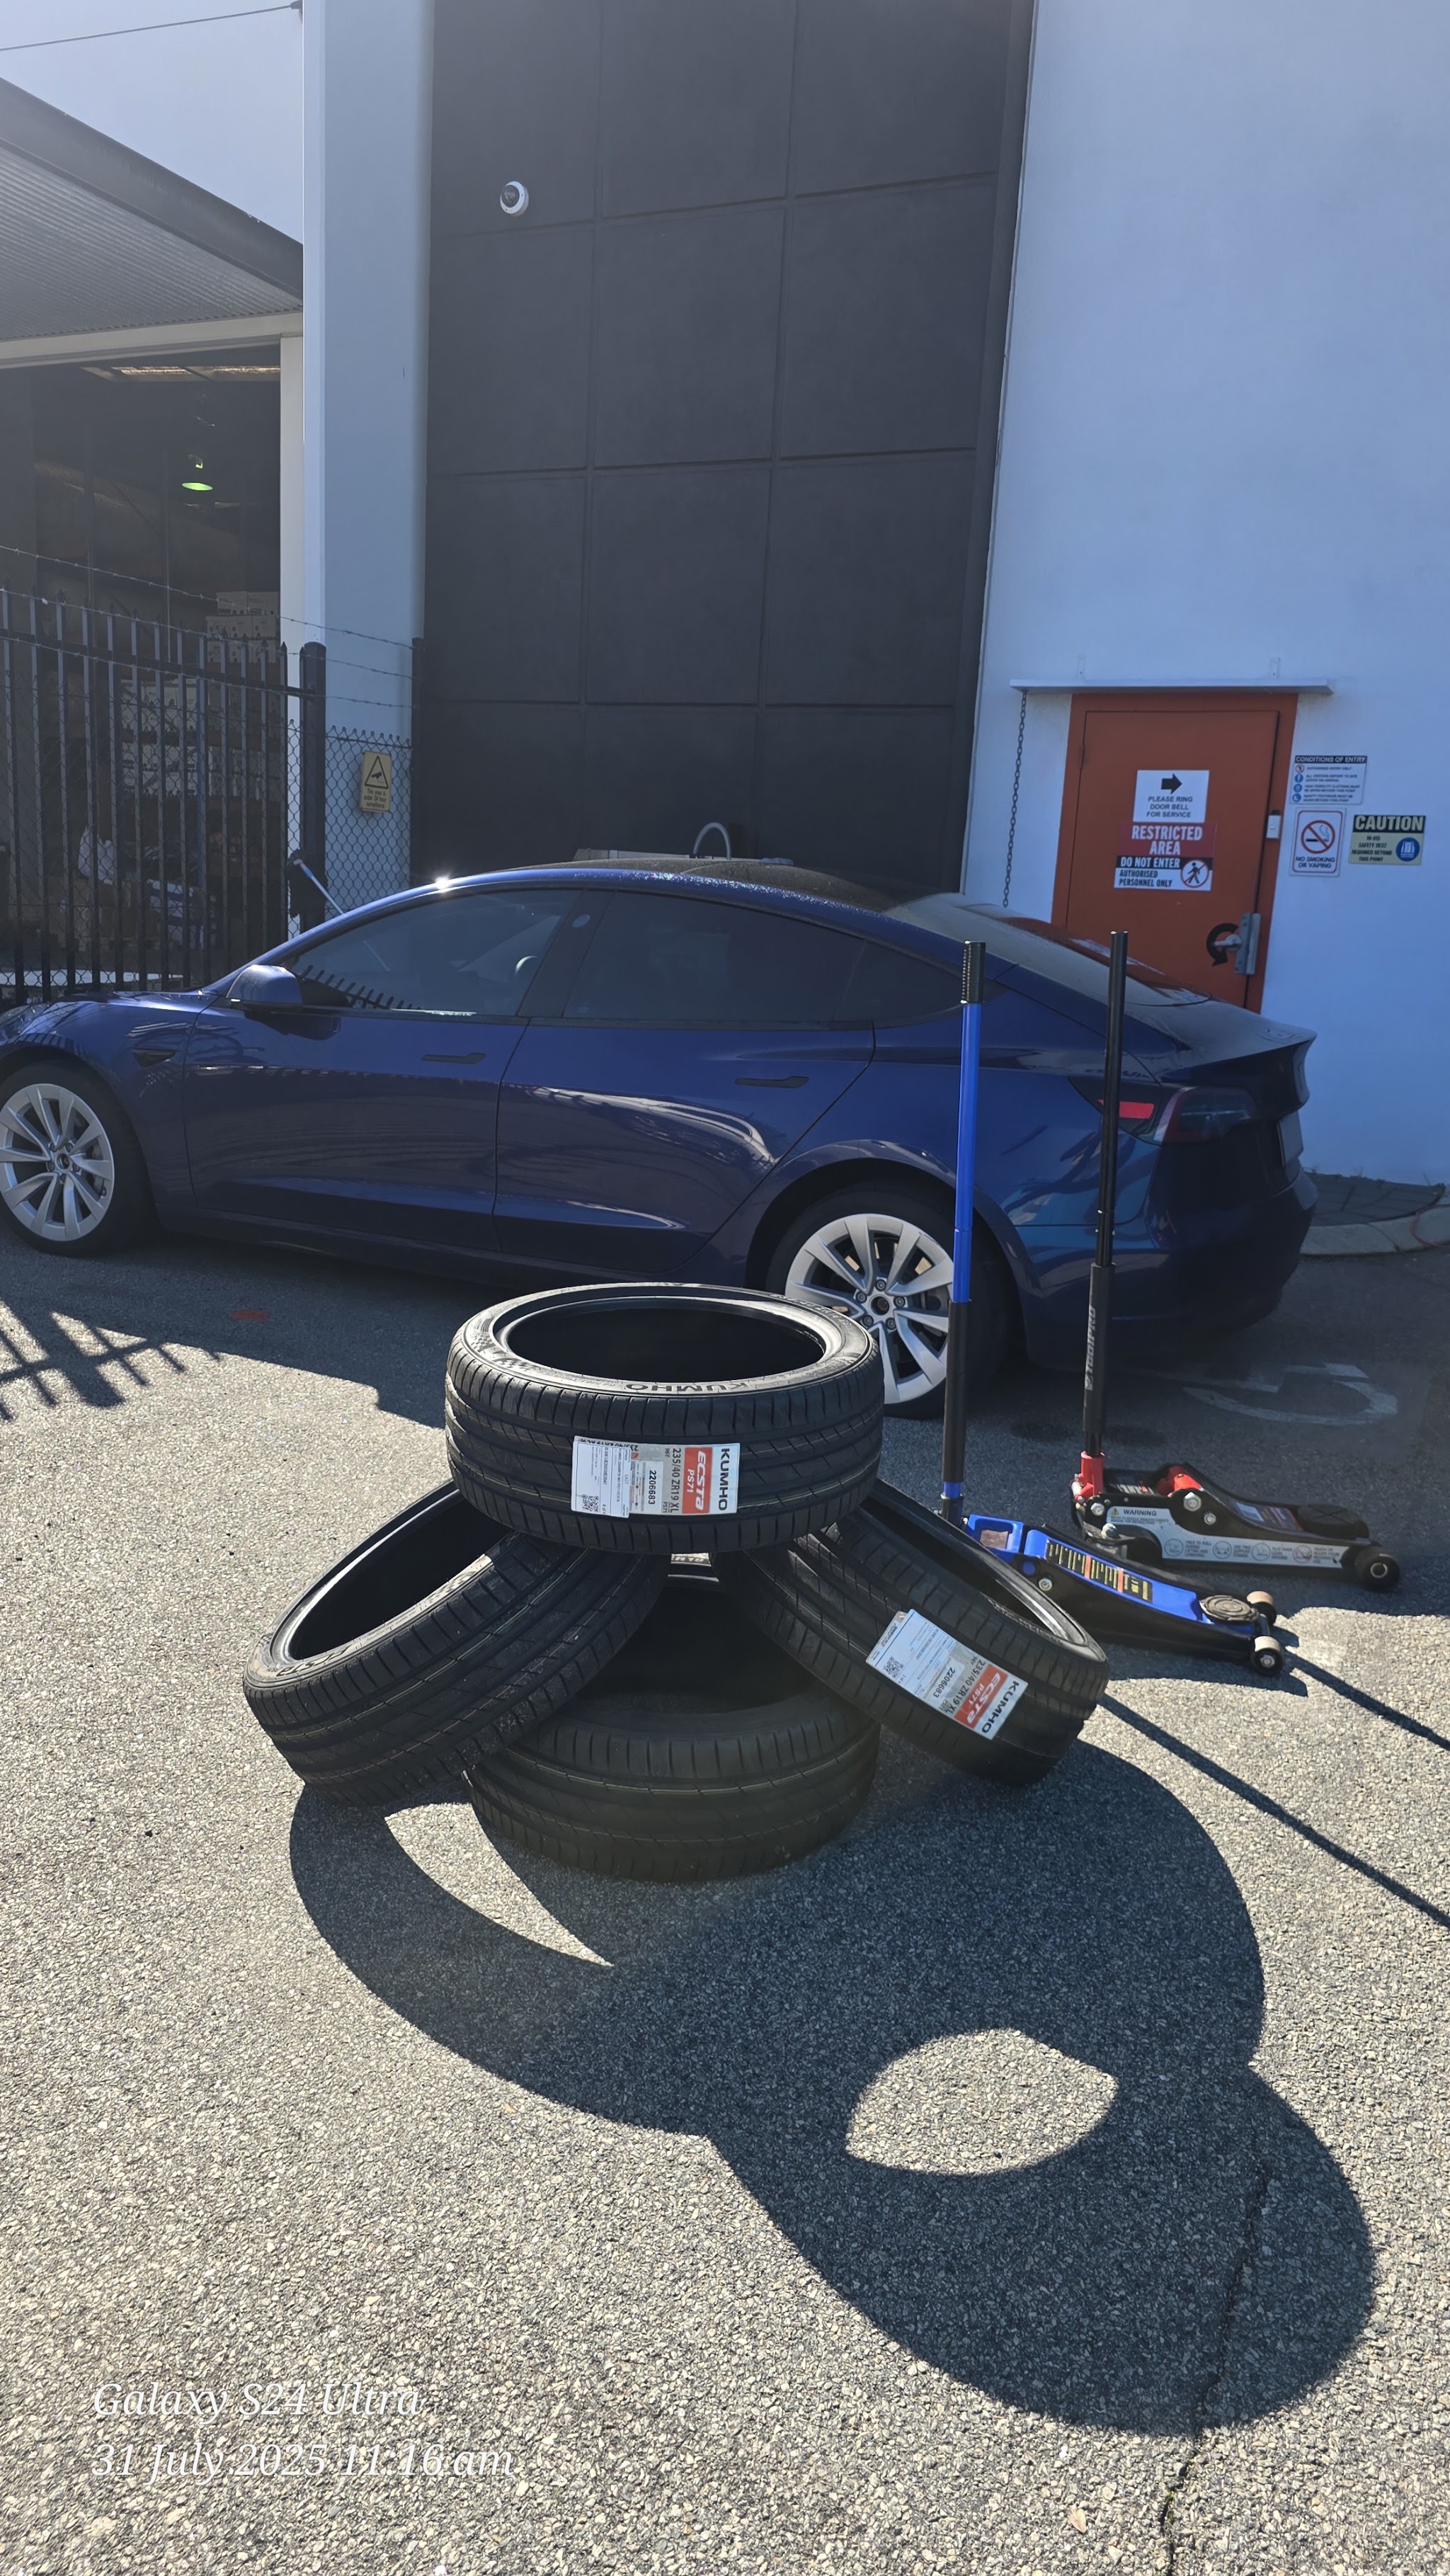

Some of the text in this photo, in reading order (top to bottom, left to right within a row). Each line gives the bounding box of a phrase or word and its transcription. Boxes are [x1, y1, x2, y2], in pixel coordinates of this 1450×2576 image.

[1354, 816, 1424, 831] CAUTION
[1131, 826, 1202, 840] RESTRICTED
[1149, 840, 1181, 855] AREA
[1120, 857, 1180, 868] DO NOT ENTER
[1119, 870, 1158, 878] AUTHORISED
[1119, 878, 1154, 887] PERSONNEL
[626, 1382, 750, 1392] KUMHO
[670, 1448, 681, 1513] 235/40 ZR19 XL
[718, 1448, 730, 1511] KUMHO
[933, 1667, 956, 1698] 2206683
[945, 1660, 986, 1714] 235/40 ZR19 XL
[969, 1683, 984, 1705] PS71
[982, 1680, 1020, 1733] KUMHO
